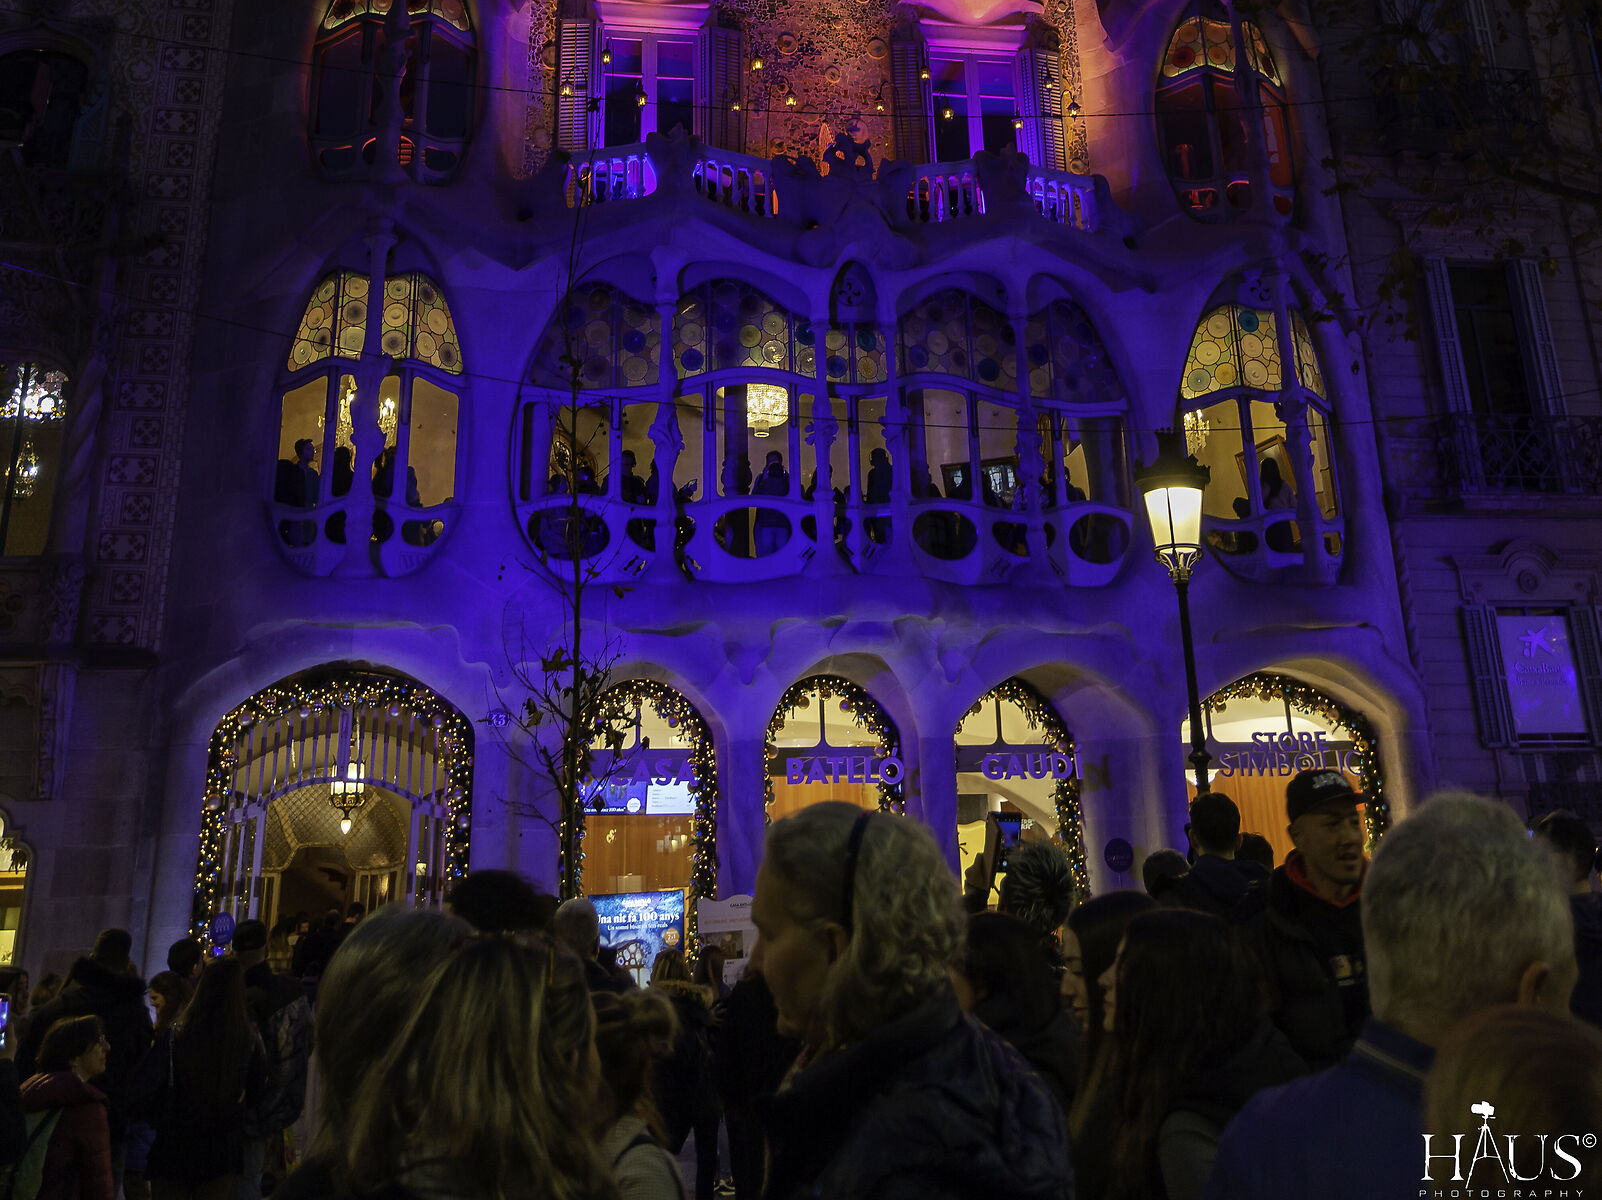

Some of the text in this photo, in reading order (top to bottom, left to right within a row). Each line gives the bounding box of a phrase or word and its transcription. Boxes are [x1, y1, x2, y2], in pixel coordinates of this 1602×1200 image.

[1251, 731, 1329, 752] STORE
[608, 744, 1084, 786] CASA BATLLÓ GAUDÍ
[613, 914, 627, 923] nit
[639, 911, 658, 921] 100
[659, 912, 680, 923] anys
